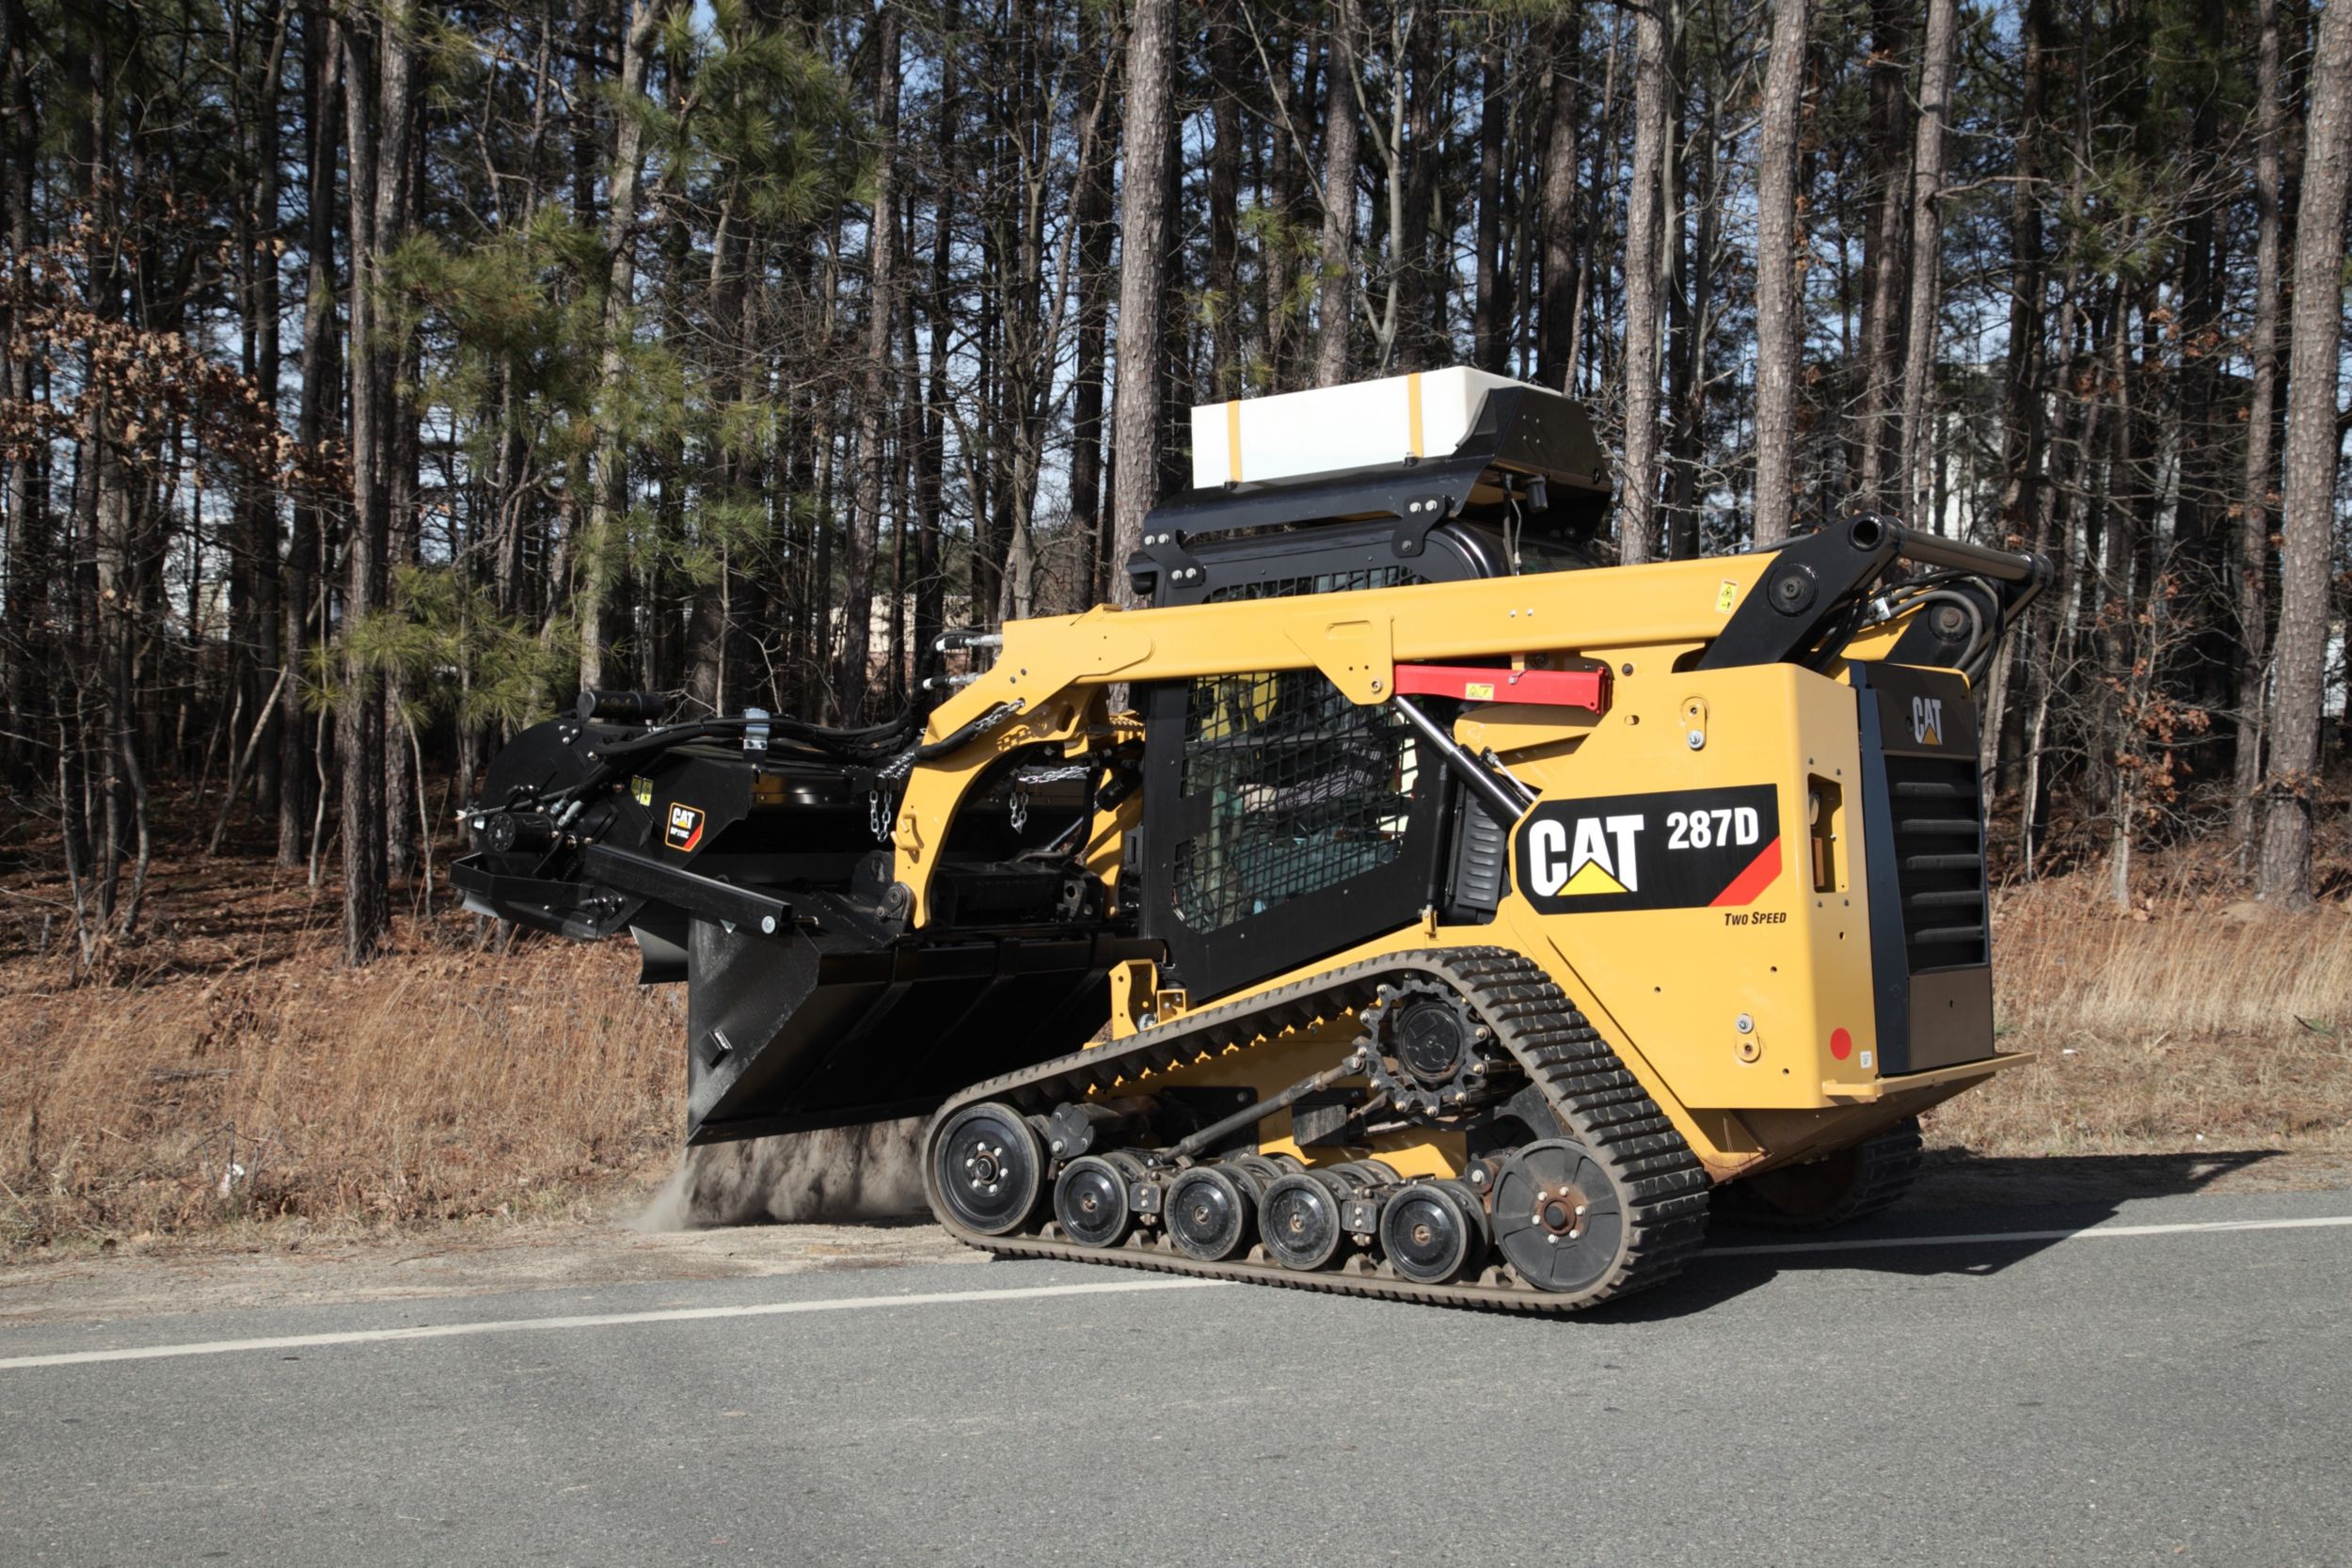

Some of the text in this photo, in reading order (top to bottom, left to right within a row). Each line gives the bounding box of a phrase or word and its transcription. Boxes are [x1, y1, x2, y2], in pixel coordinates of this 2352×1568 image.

[1912, 696, 1943, 745] CAT
[672, 807, 695, 830] CAT
[1529, 807, 1758, 896] CAT 287D
